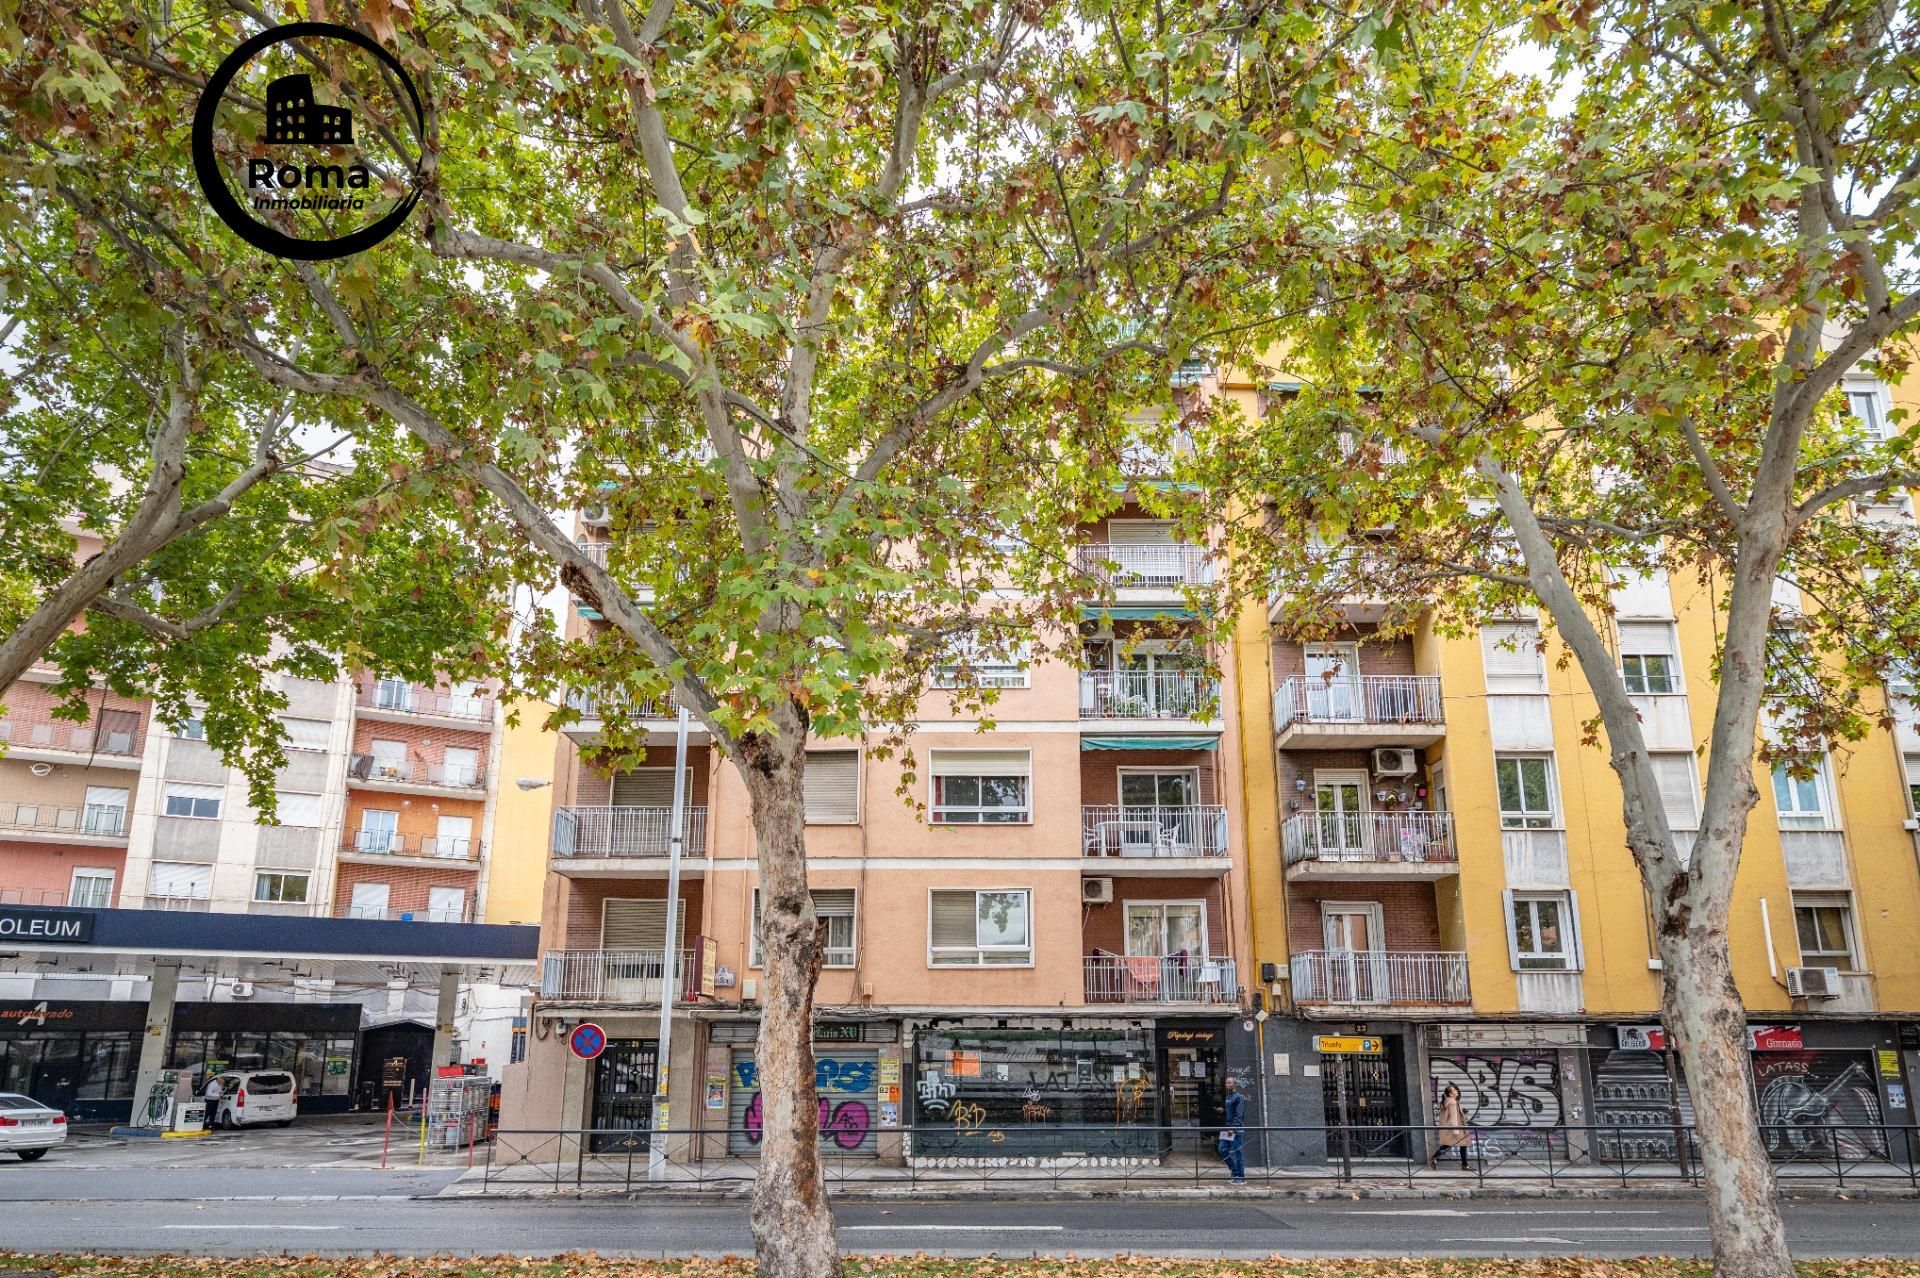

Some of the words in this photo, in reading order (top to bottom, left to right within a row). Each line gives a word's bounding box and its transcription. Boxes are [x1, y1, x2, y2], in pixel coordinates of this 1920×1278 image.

[0, 918, 81, 937] OLEUM
[1321, 1041, 1342, 1049] Triunfo
[1766, 1038, 1803, 1049] Gimnasio
